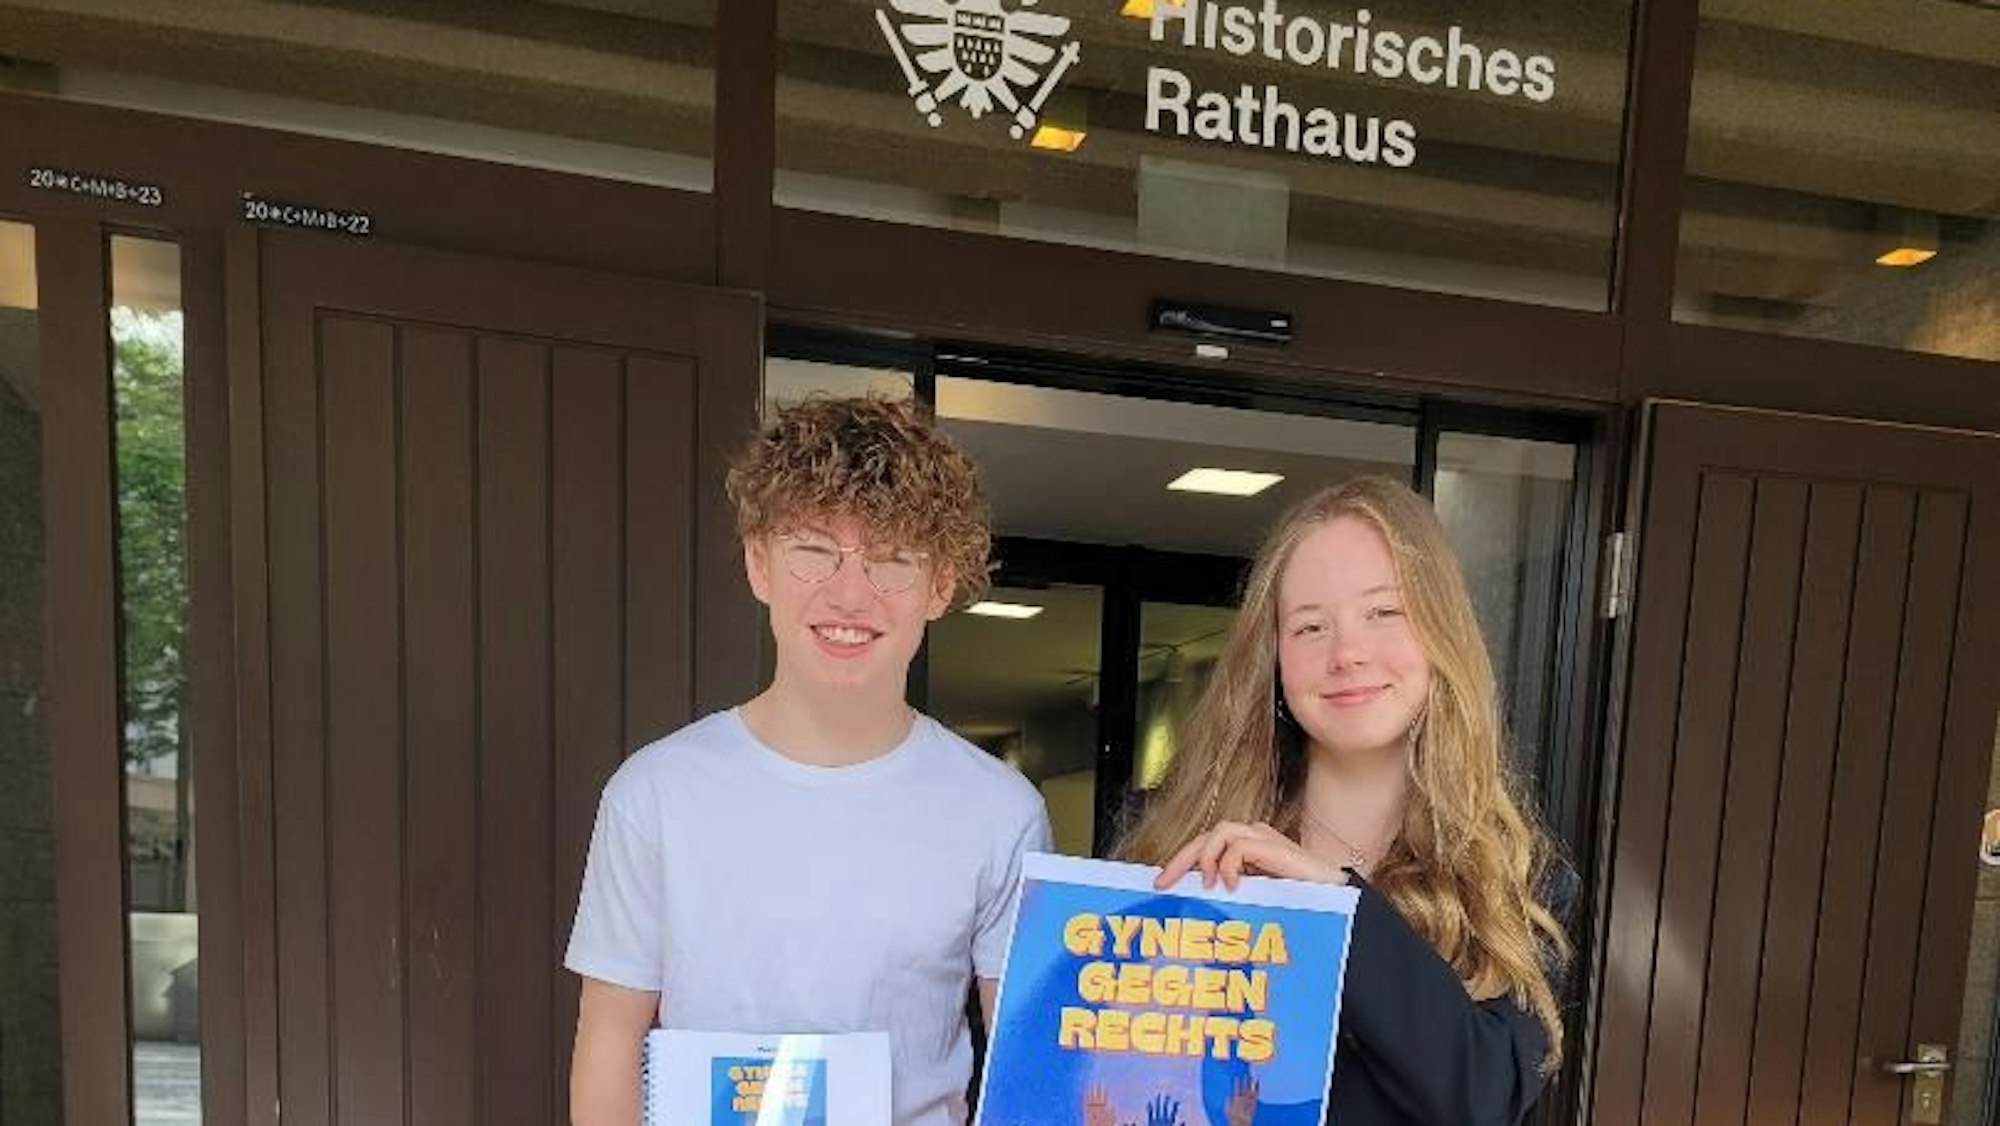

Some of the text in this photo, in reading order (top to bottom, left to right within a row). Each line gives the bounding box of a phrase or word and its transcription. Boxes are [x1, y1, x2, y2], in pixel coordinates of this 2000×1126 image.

[1149, 0, 1556, 102] Historisches
[1145, 67, 1417, 168] Rathaus
[1063, 912, 1288, 965] GYNESA
[1078, 961, 1268, 1012] GEGEN
[1058, 1007, 1277, 1063] RECHTS
